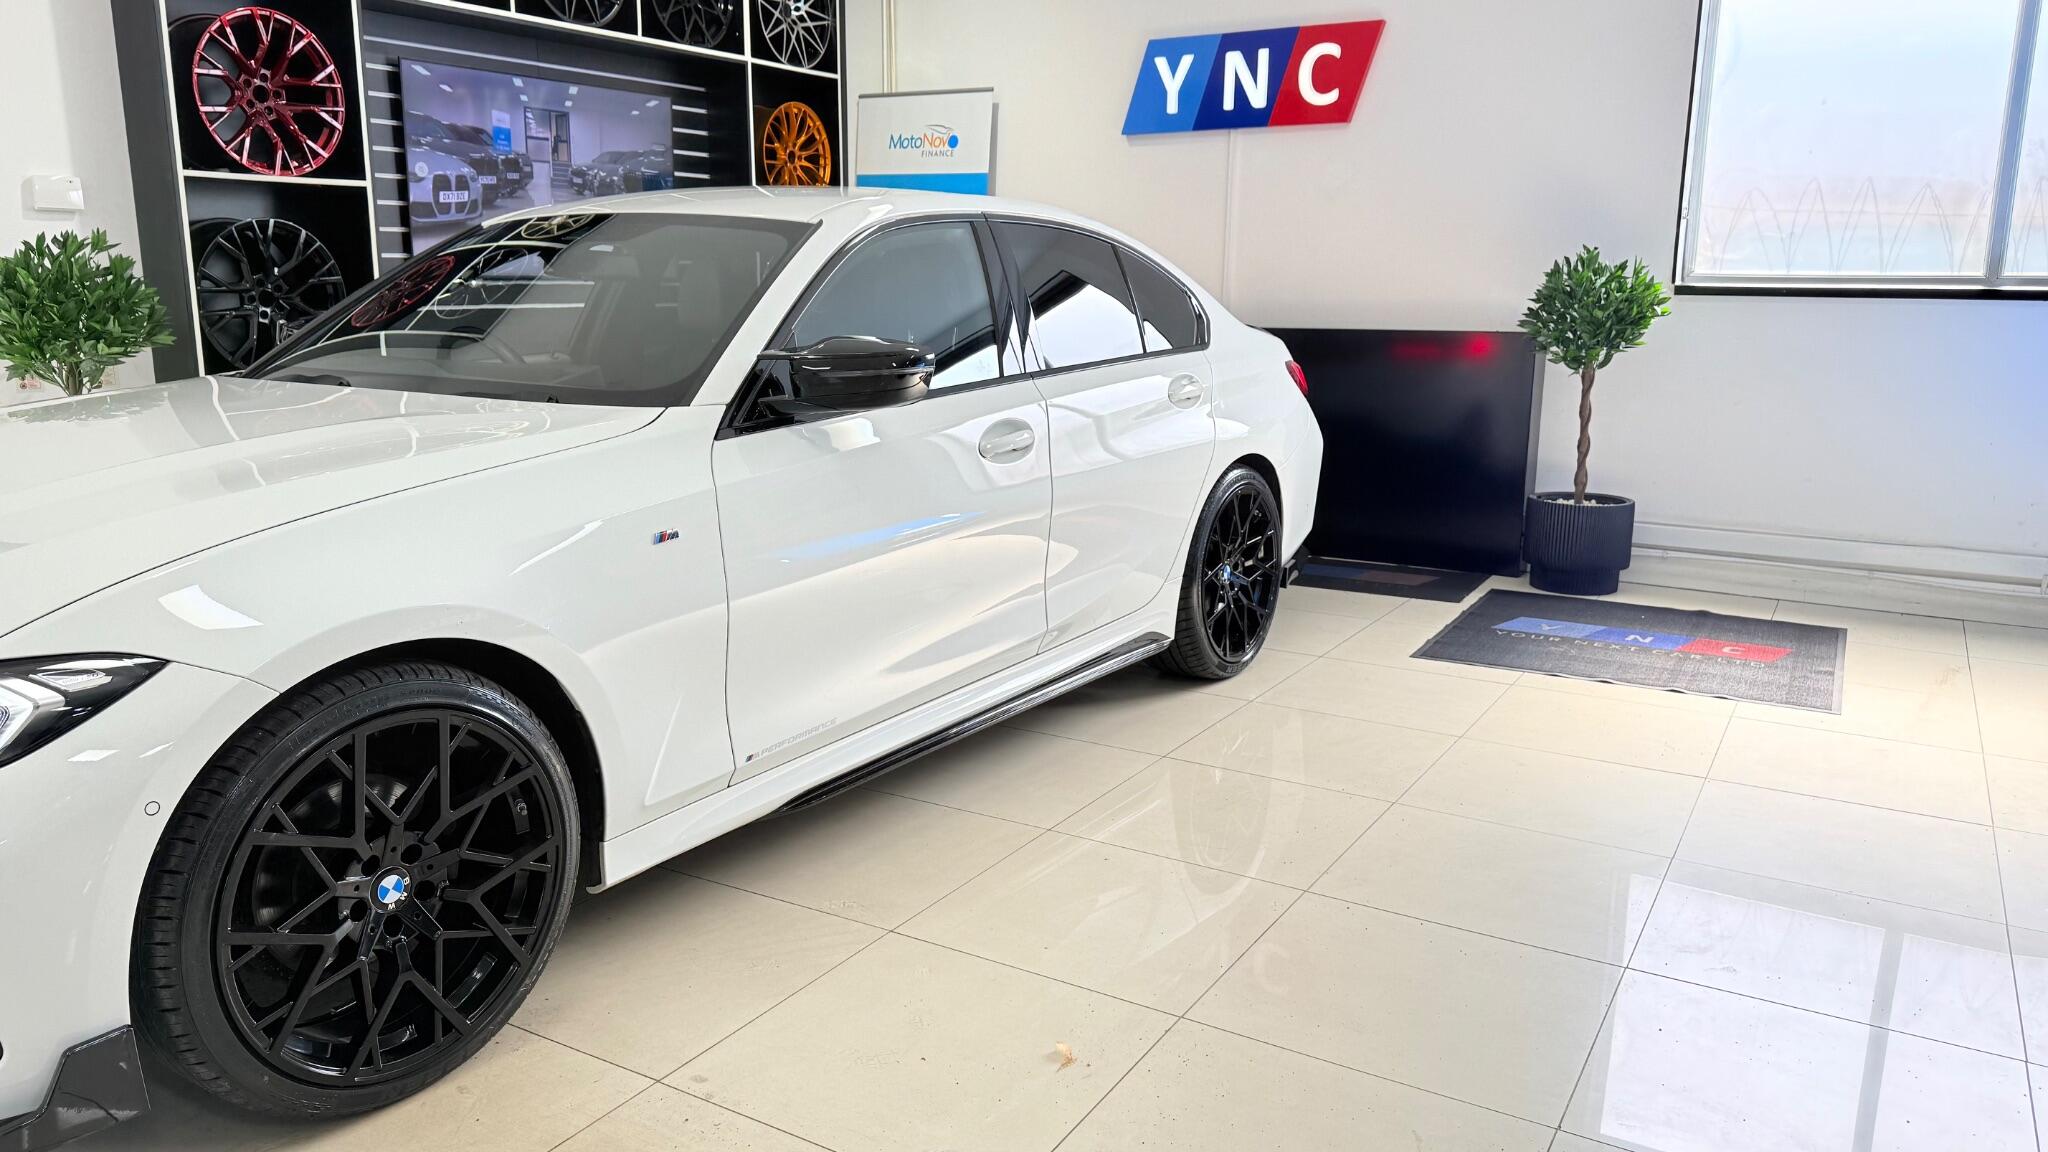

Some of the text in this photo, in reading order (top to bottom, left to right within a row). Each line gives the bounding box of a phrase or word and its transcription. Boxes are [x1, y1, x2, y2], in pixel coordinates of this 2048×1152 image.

[1154, 42, 1341, 114] YNC
[921, 149, 954, 158] FINANCE
[1496, 629, 1561, 642] YOUR
[1574, 639, 1641, 652] NEXT
[1652, 649, 1702, 659] CAR
